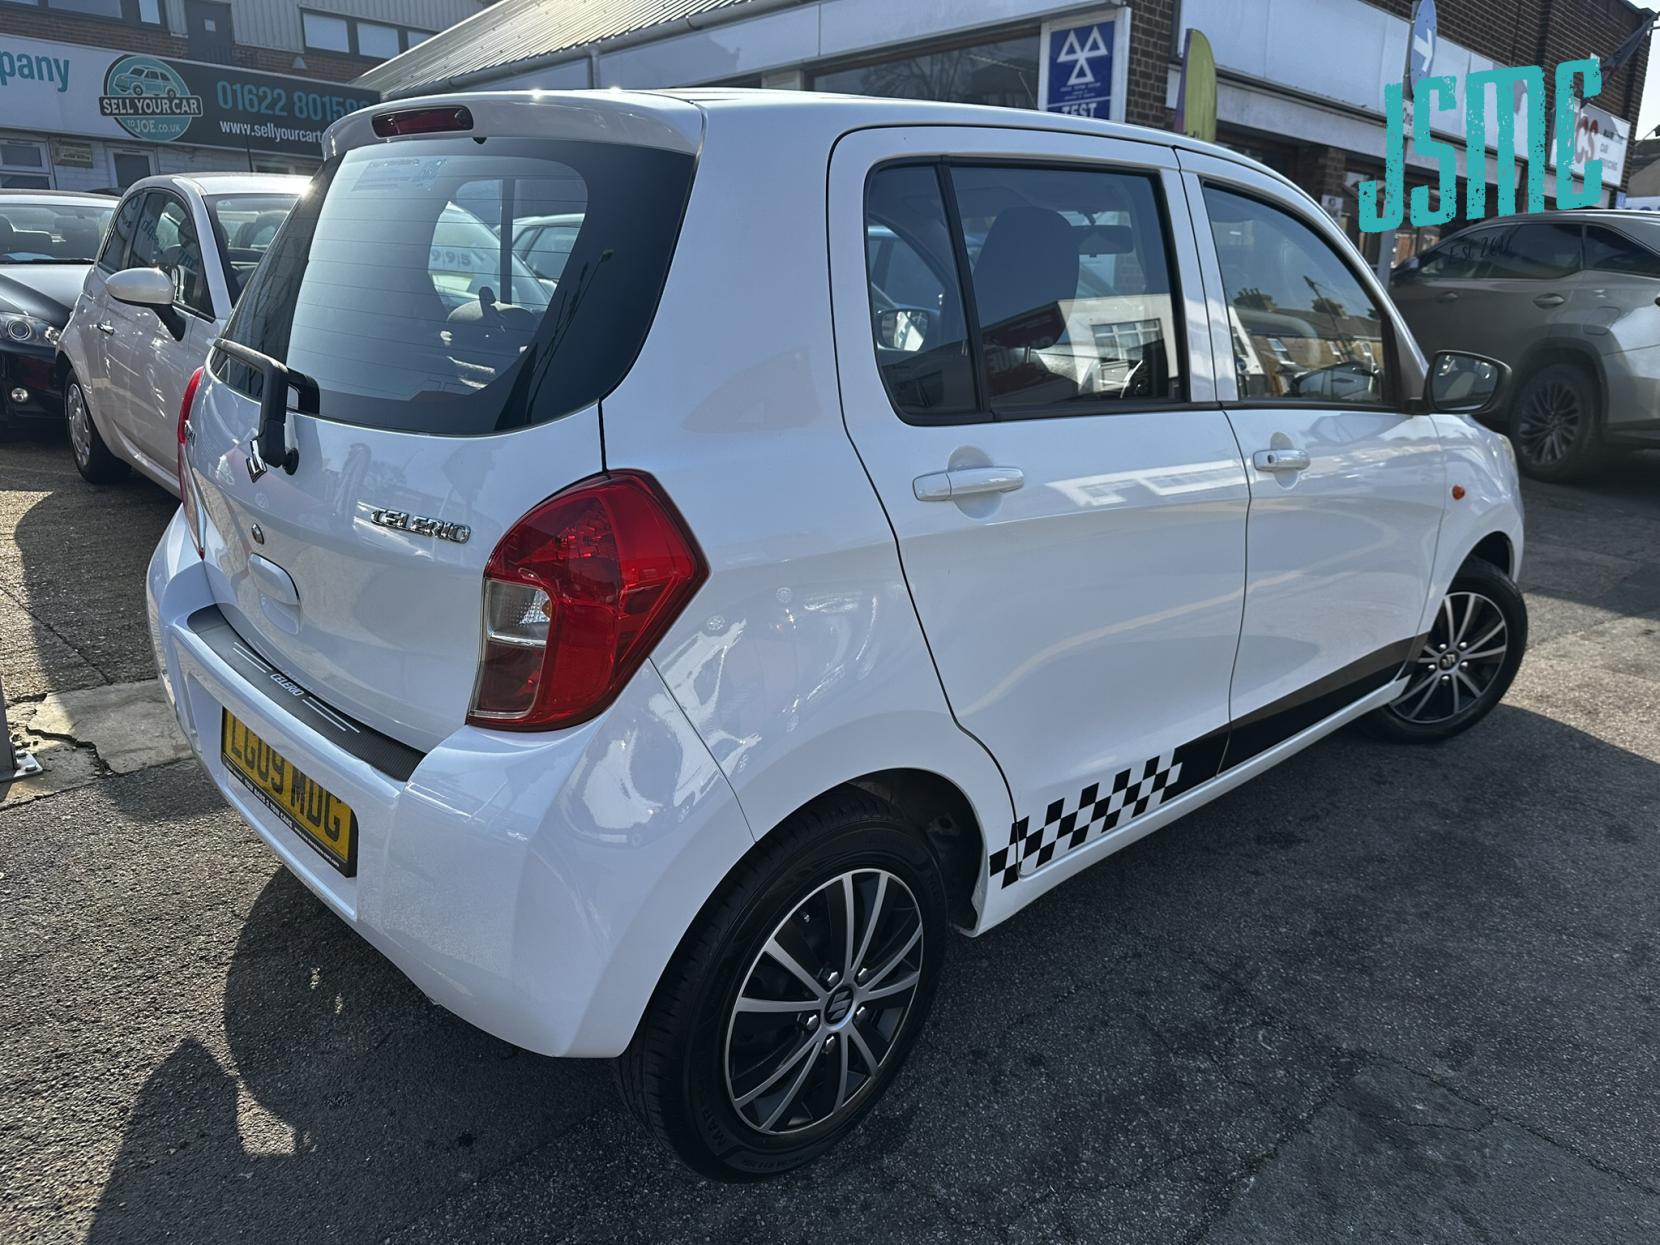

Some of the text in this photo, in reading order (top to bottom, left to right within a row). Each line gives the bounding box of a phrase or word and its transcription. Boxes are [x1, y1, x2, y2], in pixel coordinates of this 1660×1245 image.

[0, 50, 70, 93] pany
[102, 98, 199, 114] SELL YOUR CAR
[216, 80, 288, 117] 01622
[1061, 102, 1097, 118] TEST
[370, 508, 472, 545] CELERIO
[270, 673, 305, 697] CELERIO
[231, 711, 286, 795] LG09
[290, 764, 341, 843] MDG
